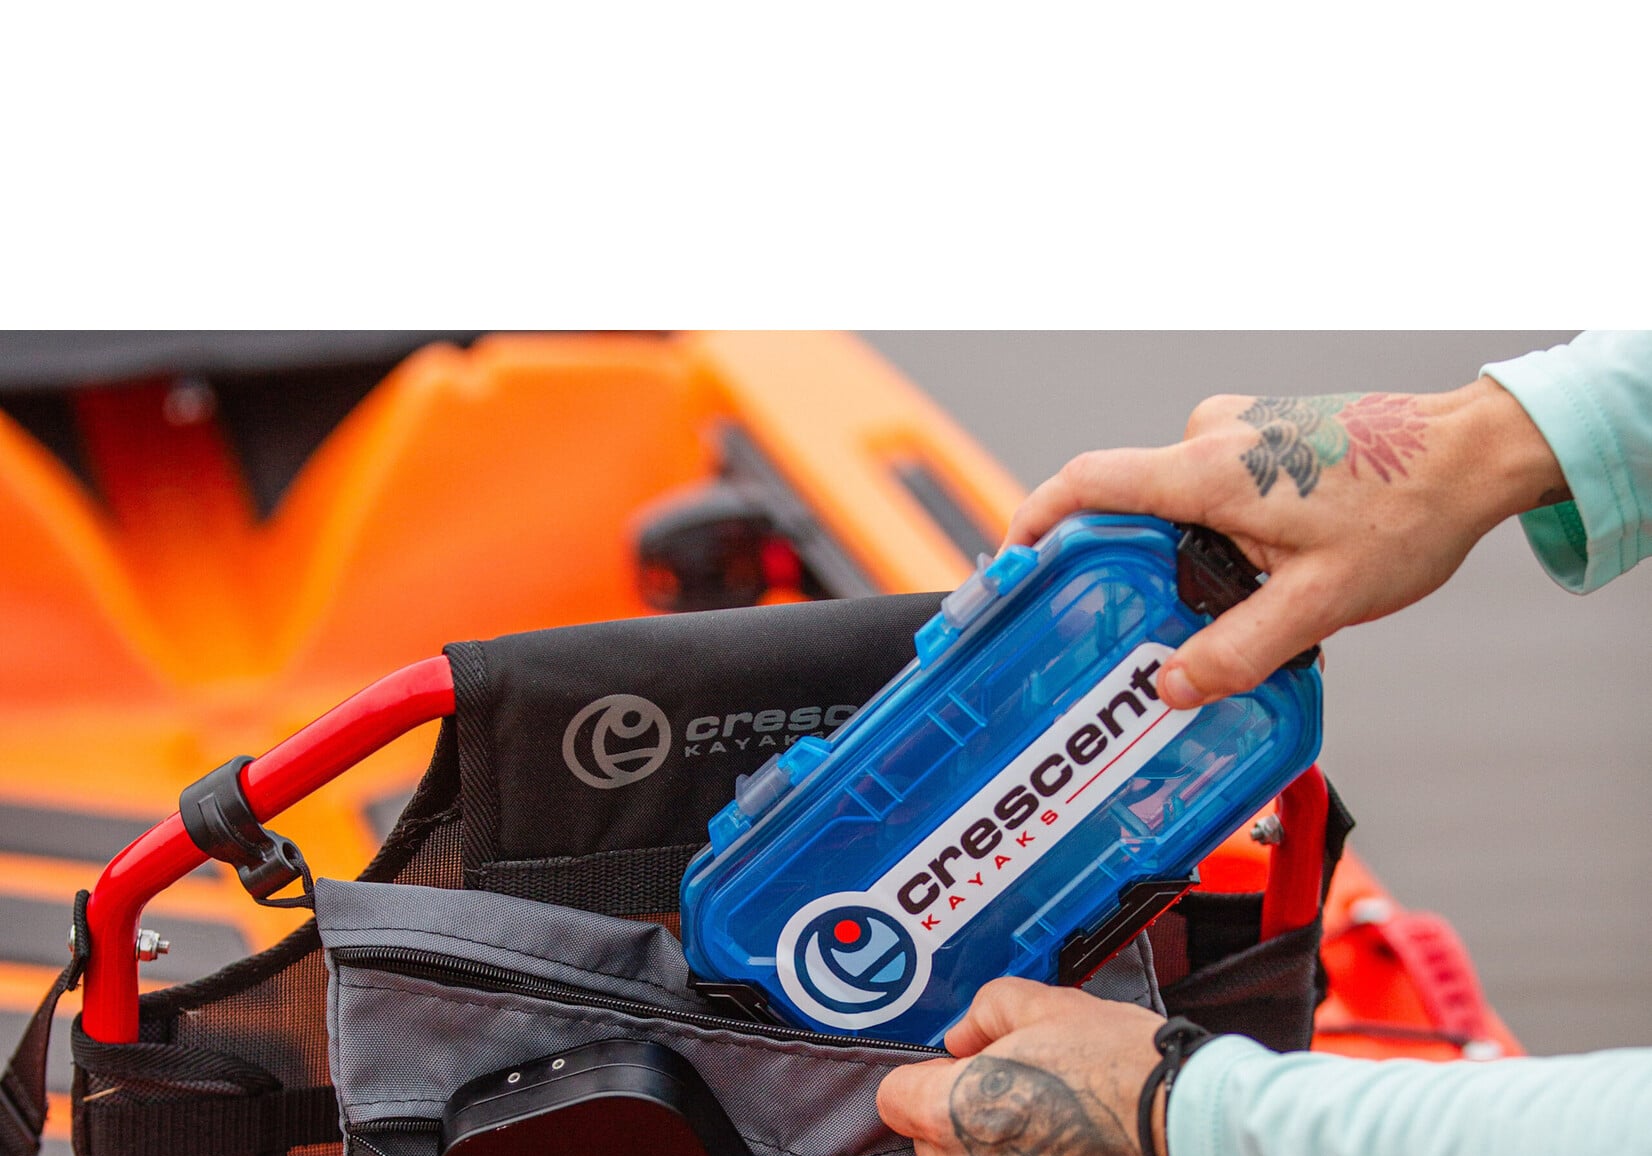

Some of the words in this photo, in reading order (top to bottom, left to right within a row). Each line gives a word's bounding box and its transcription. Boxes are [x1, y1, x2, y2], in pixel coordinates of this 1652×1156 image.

[686, 704, 858, 741] cresc
[897, 659, 1161, 915] crescent
[921, 809, 1058, 931] KAYAKS
